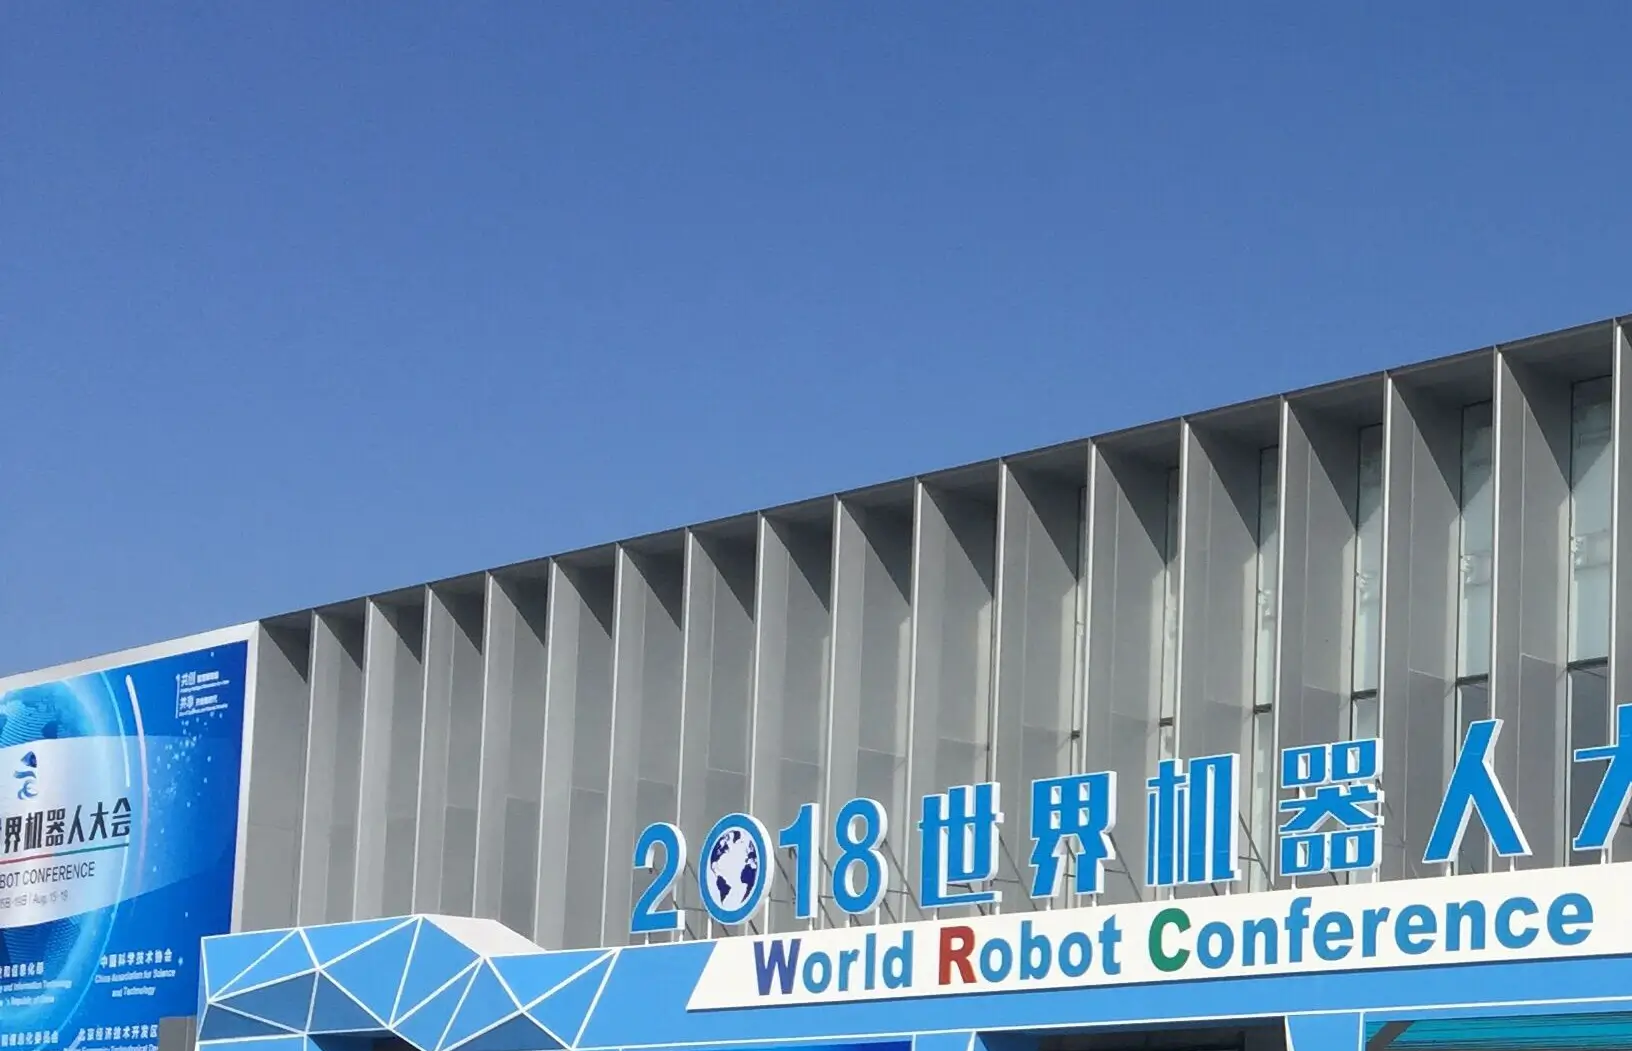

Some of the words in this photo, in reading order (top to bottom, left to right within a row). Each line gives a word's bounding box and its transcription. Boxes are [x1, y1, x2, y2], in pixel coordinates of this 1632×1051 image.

[0, 797, 131, 854] 界机器人大会
[22, 861, 95, 886] CONFERENCE
[753, 928, 914, 996] World
[937, 913, 1123, 986] Robot
[1147, 891, 1594, 973] Conference
